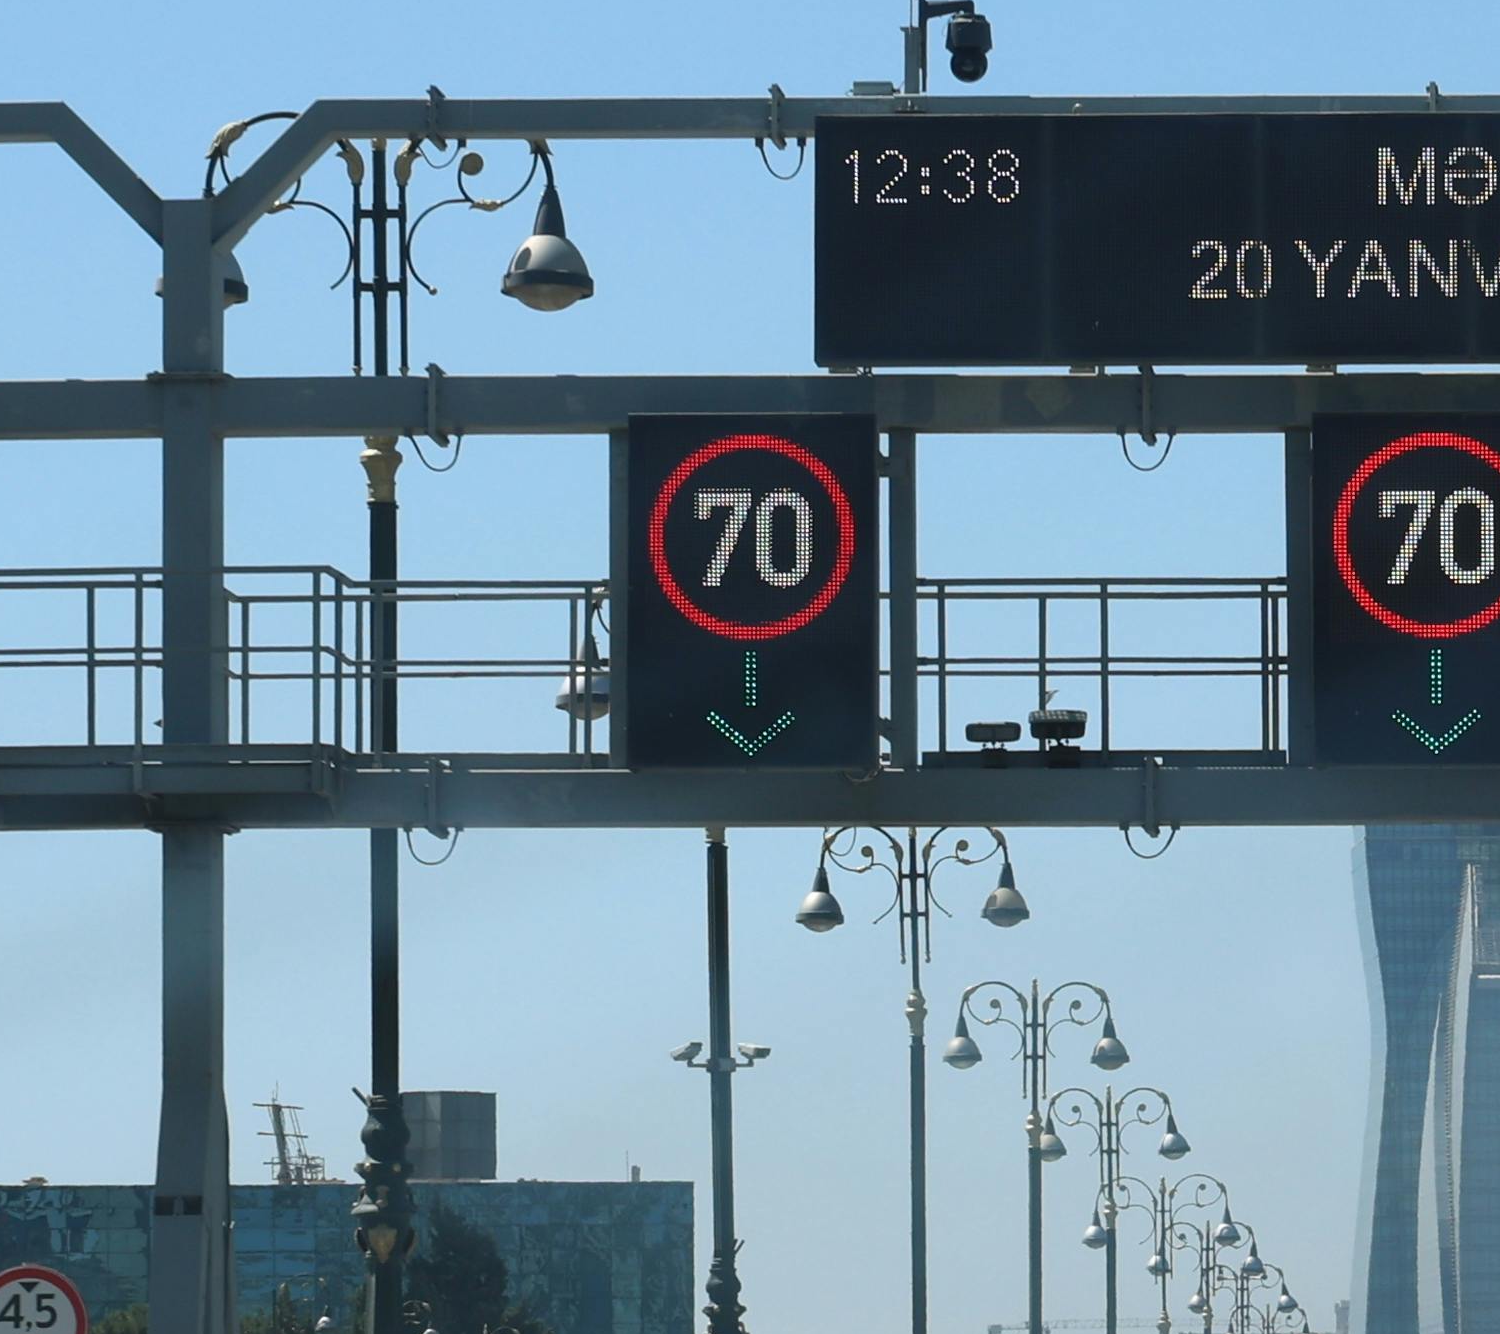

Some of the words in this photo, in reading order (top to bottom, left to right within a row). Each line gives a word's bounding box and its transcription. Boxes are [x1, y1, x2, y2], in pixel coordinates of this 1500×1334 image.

[845, 149, 1020, 204] 12:38
[1188, 240, 1272, 299] 20
[693, 486, 813, 589] 70
[1377, 486, 1496, 586] 70
